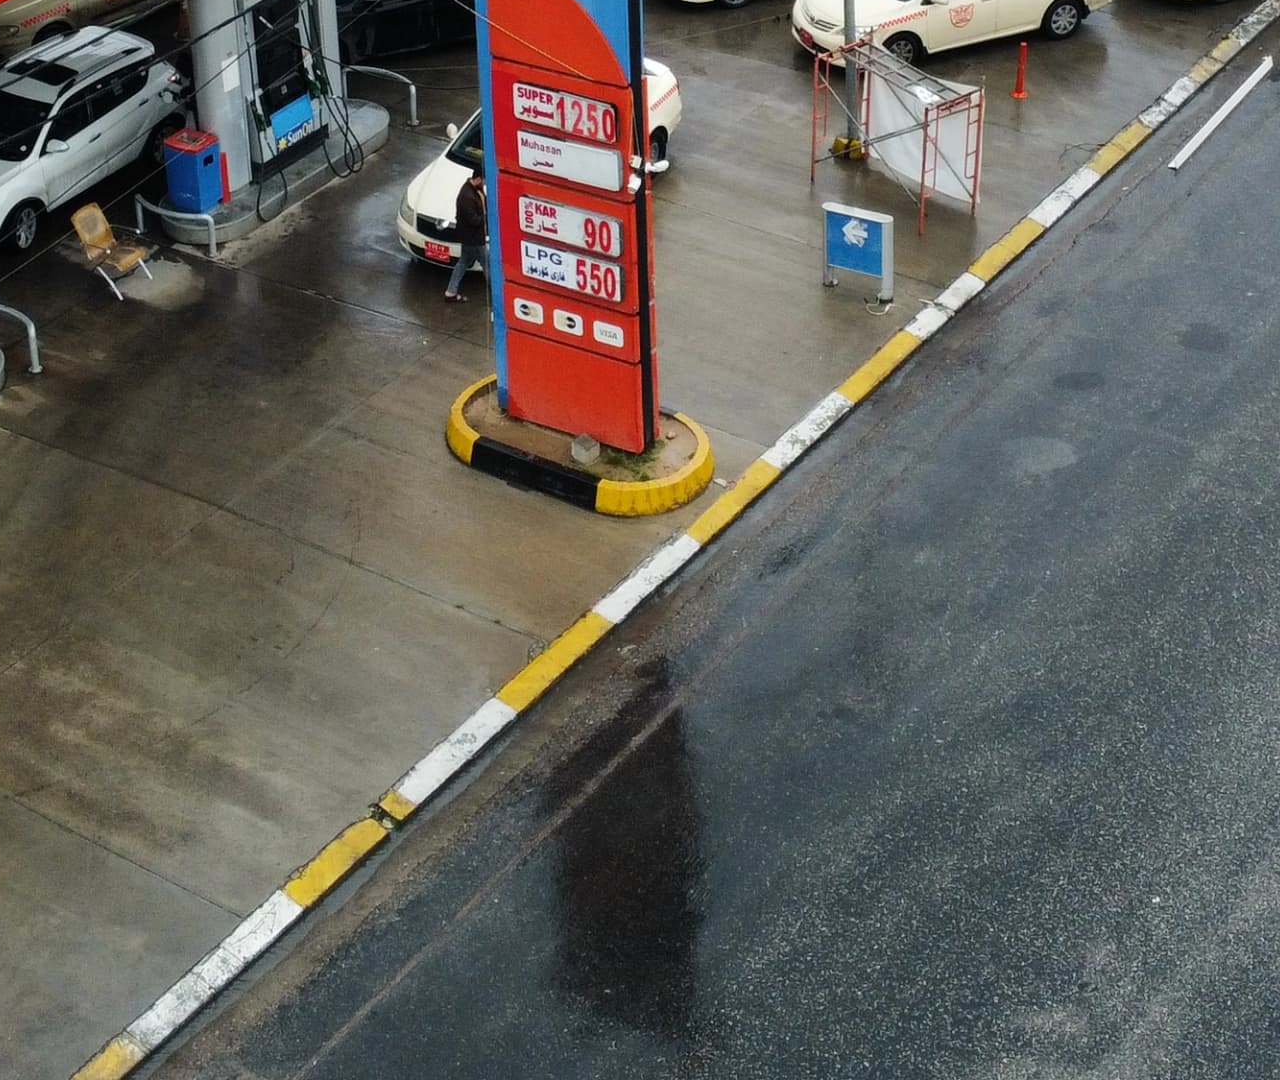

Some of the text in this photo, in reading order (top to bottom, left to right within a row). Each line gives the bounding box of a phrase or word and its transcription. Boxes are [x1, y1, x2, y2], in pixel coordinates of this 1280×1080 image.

[517, 87, 555, 106] SUPER
[556, 96, 616, 142] 1250
[534, 202, 558, 220] KAR
[583, 217, 612, 253] 90
[525, 245, 563, 266] LPG
[576, 258, 617, 300] 550
